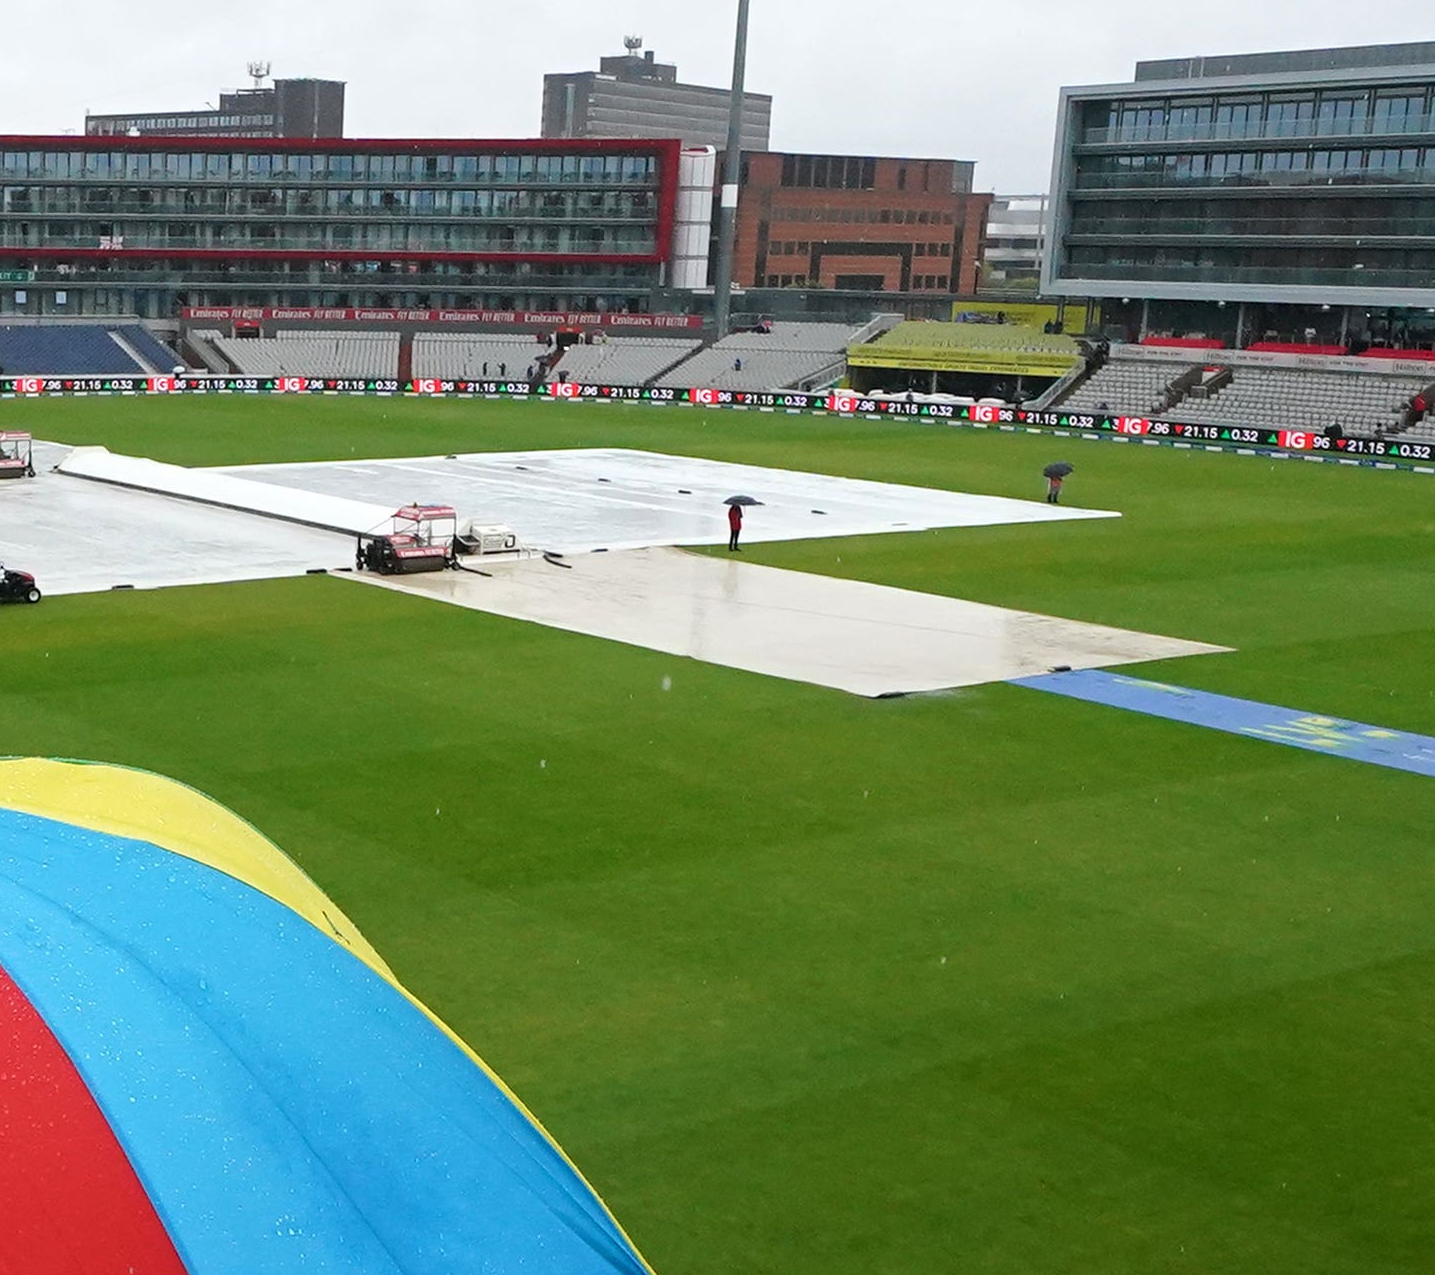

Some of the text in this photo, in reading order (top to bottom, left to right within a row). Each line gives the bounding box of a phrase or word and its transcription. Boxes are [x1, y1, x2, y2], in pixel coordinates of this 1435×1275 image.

[1285, 431, 1431, 458] IG 21.15 0.32
